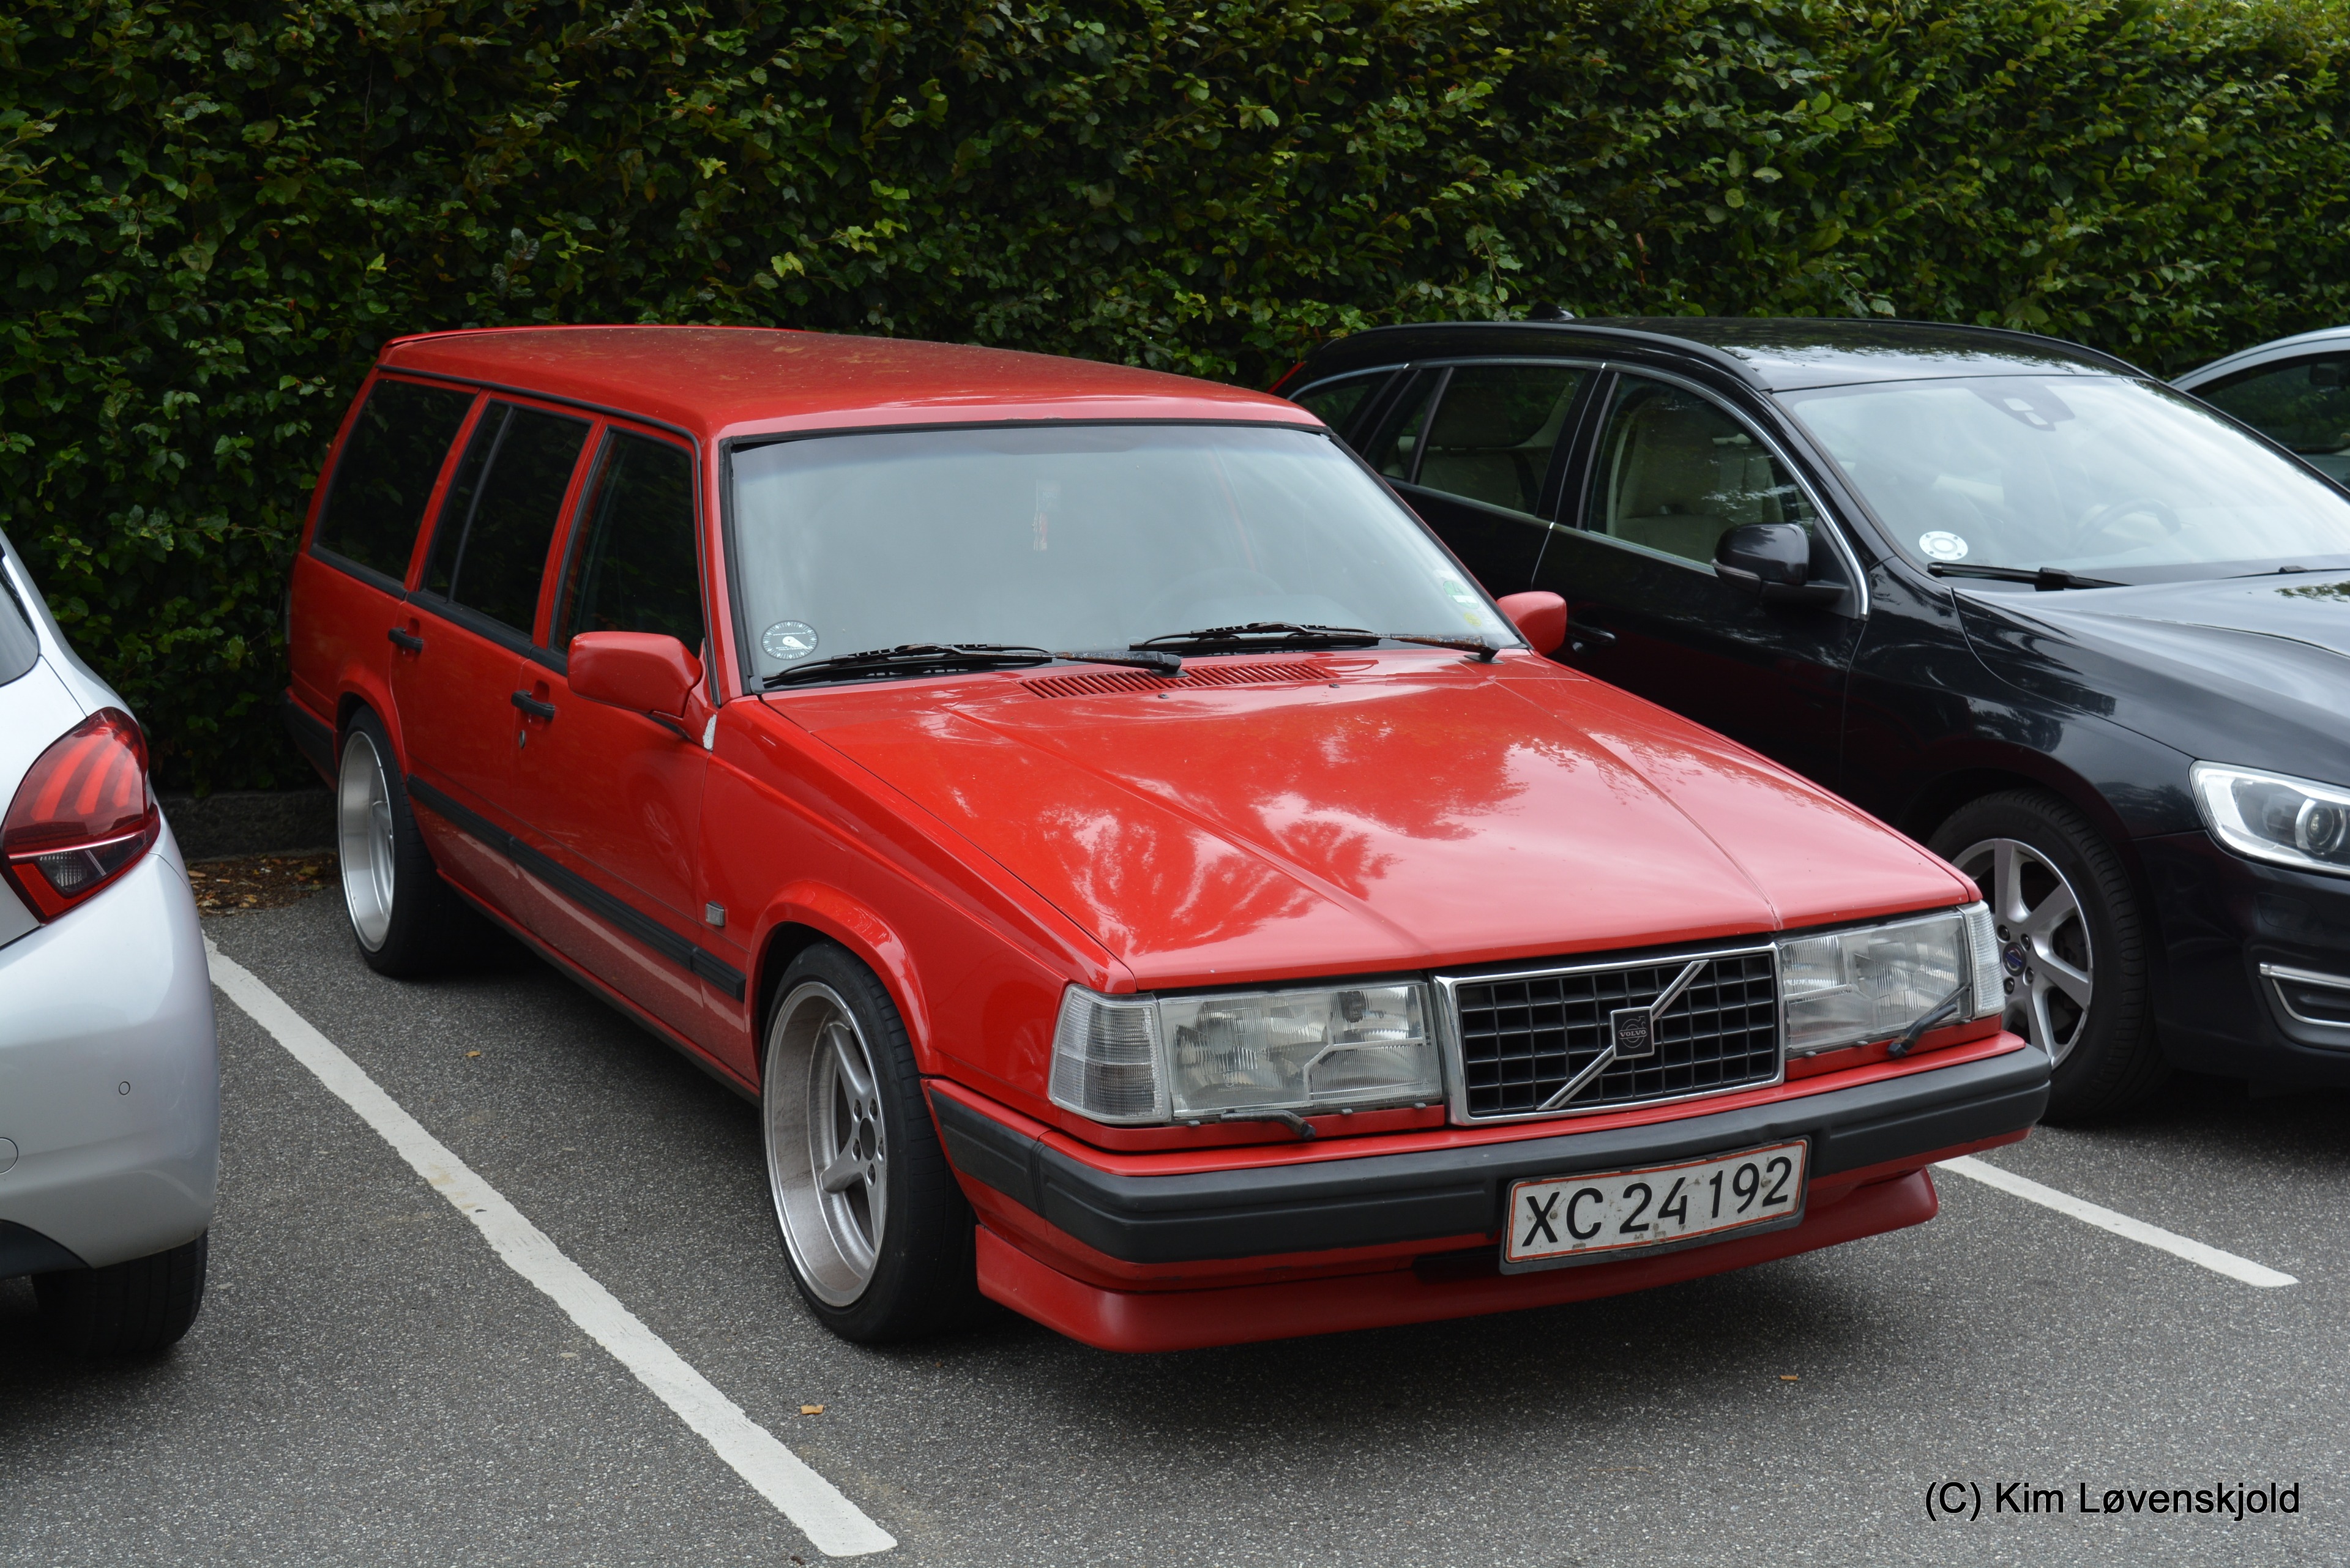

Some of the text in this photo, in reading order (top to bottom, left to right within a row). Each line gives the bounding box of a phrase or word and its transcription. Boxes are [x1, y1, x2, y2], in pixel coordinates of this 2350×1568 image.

[1522, 1156, 1792, 1247] XC 24 192
